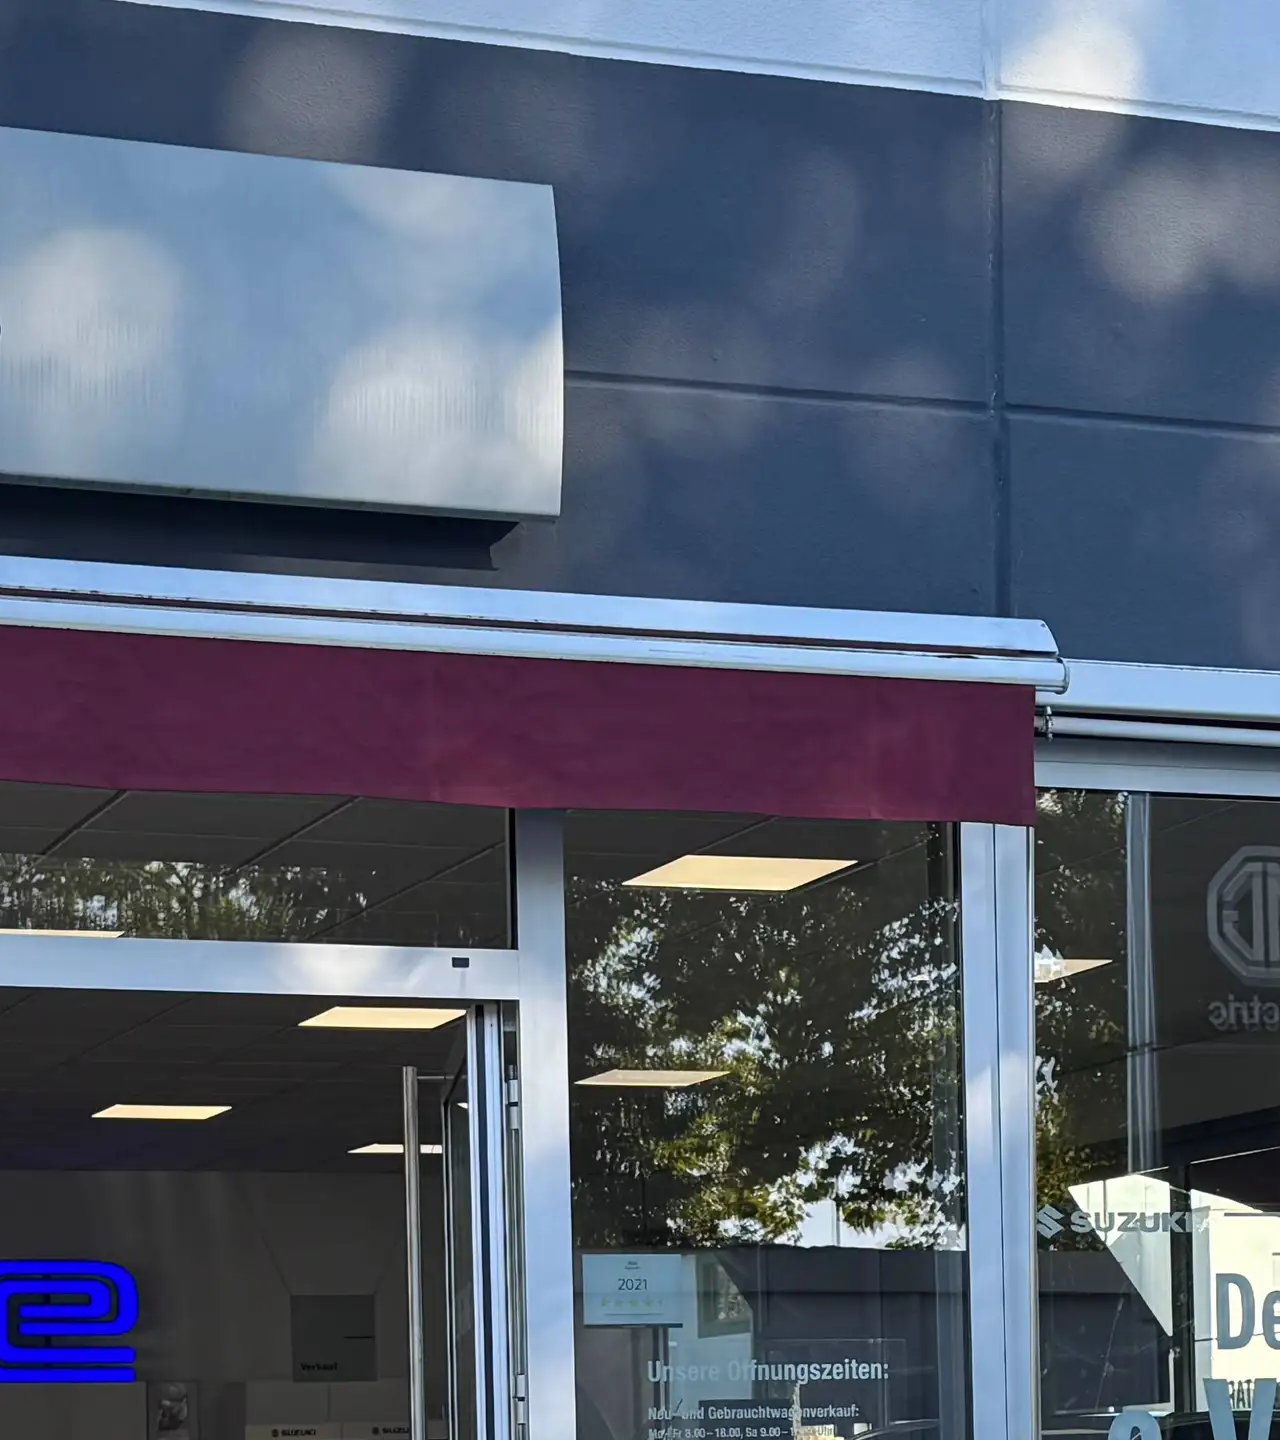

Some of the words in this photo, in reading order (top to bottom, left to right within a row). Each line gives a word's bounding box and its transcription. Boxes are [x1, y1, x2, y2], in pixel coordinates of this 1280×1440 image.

[1070, 1211, 1193, 1234] SUZUKI
[618, 1278, 648, 1291] 2021
[646, 1360, 719, 1383] Unsere
[681, 1407, 704, 1420] und
[707, 1405, 860, 1421] Gebrauchtwagnverkauf:
[746, 1427, 758, 1437] Sa
